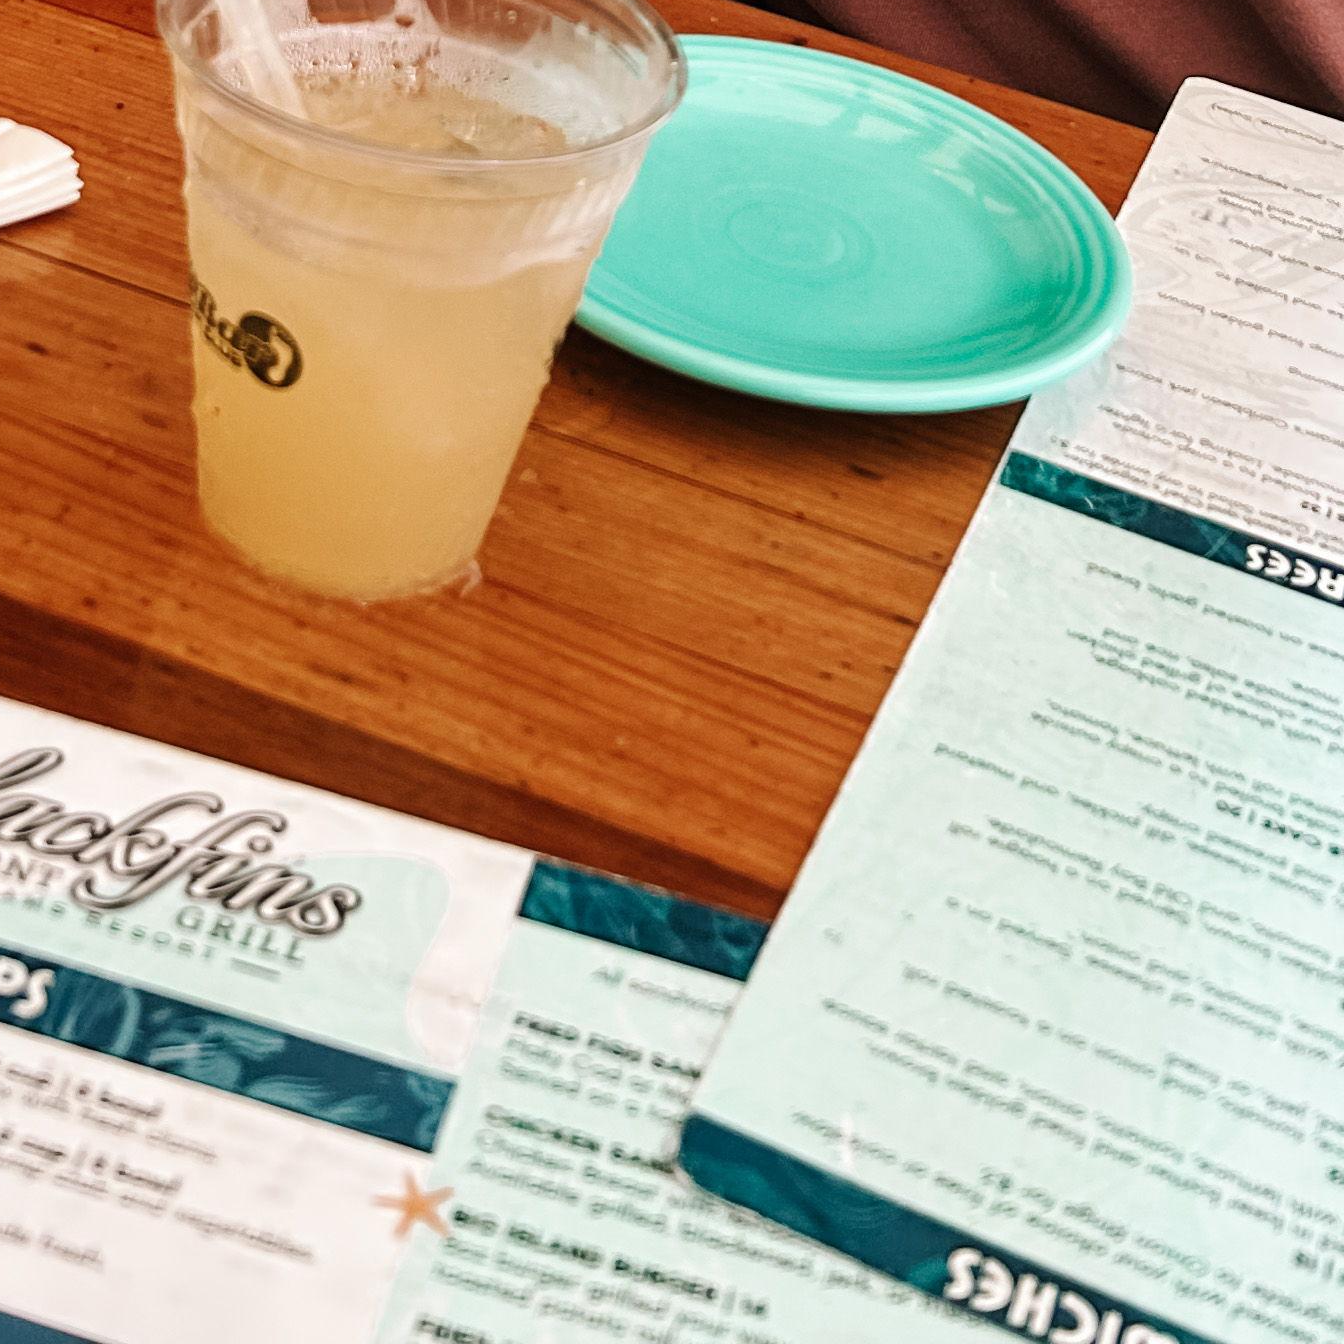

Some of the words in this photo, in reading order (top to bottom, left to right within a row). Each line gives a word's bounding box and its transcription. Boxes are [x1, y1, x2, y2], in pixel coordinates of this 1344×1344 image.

[1260, 815, 1323, 849] CAKE
[175, 903, 307, 962] GRILL
[505, 1220, 605, 1264] ISLAND
